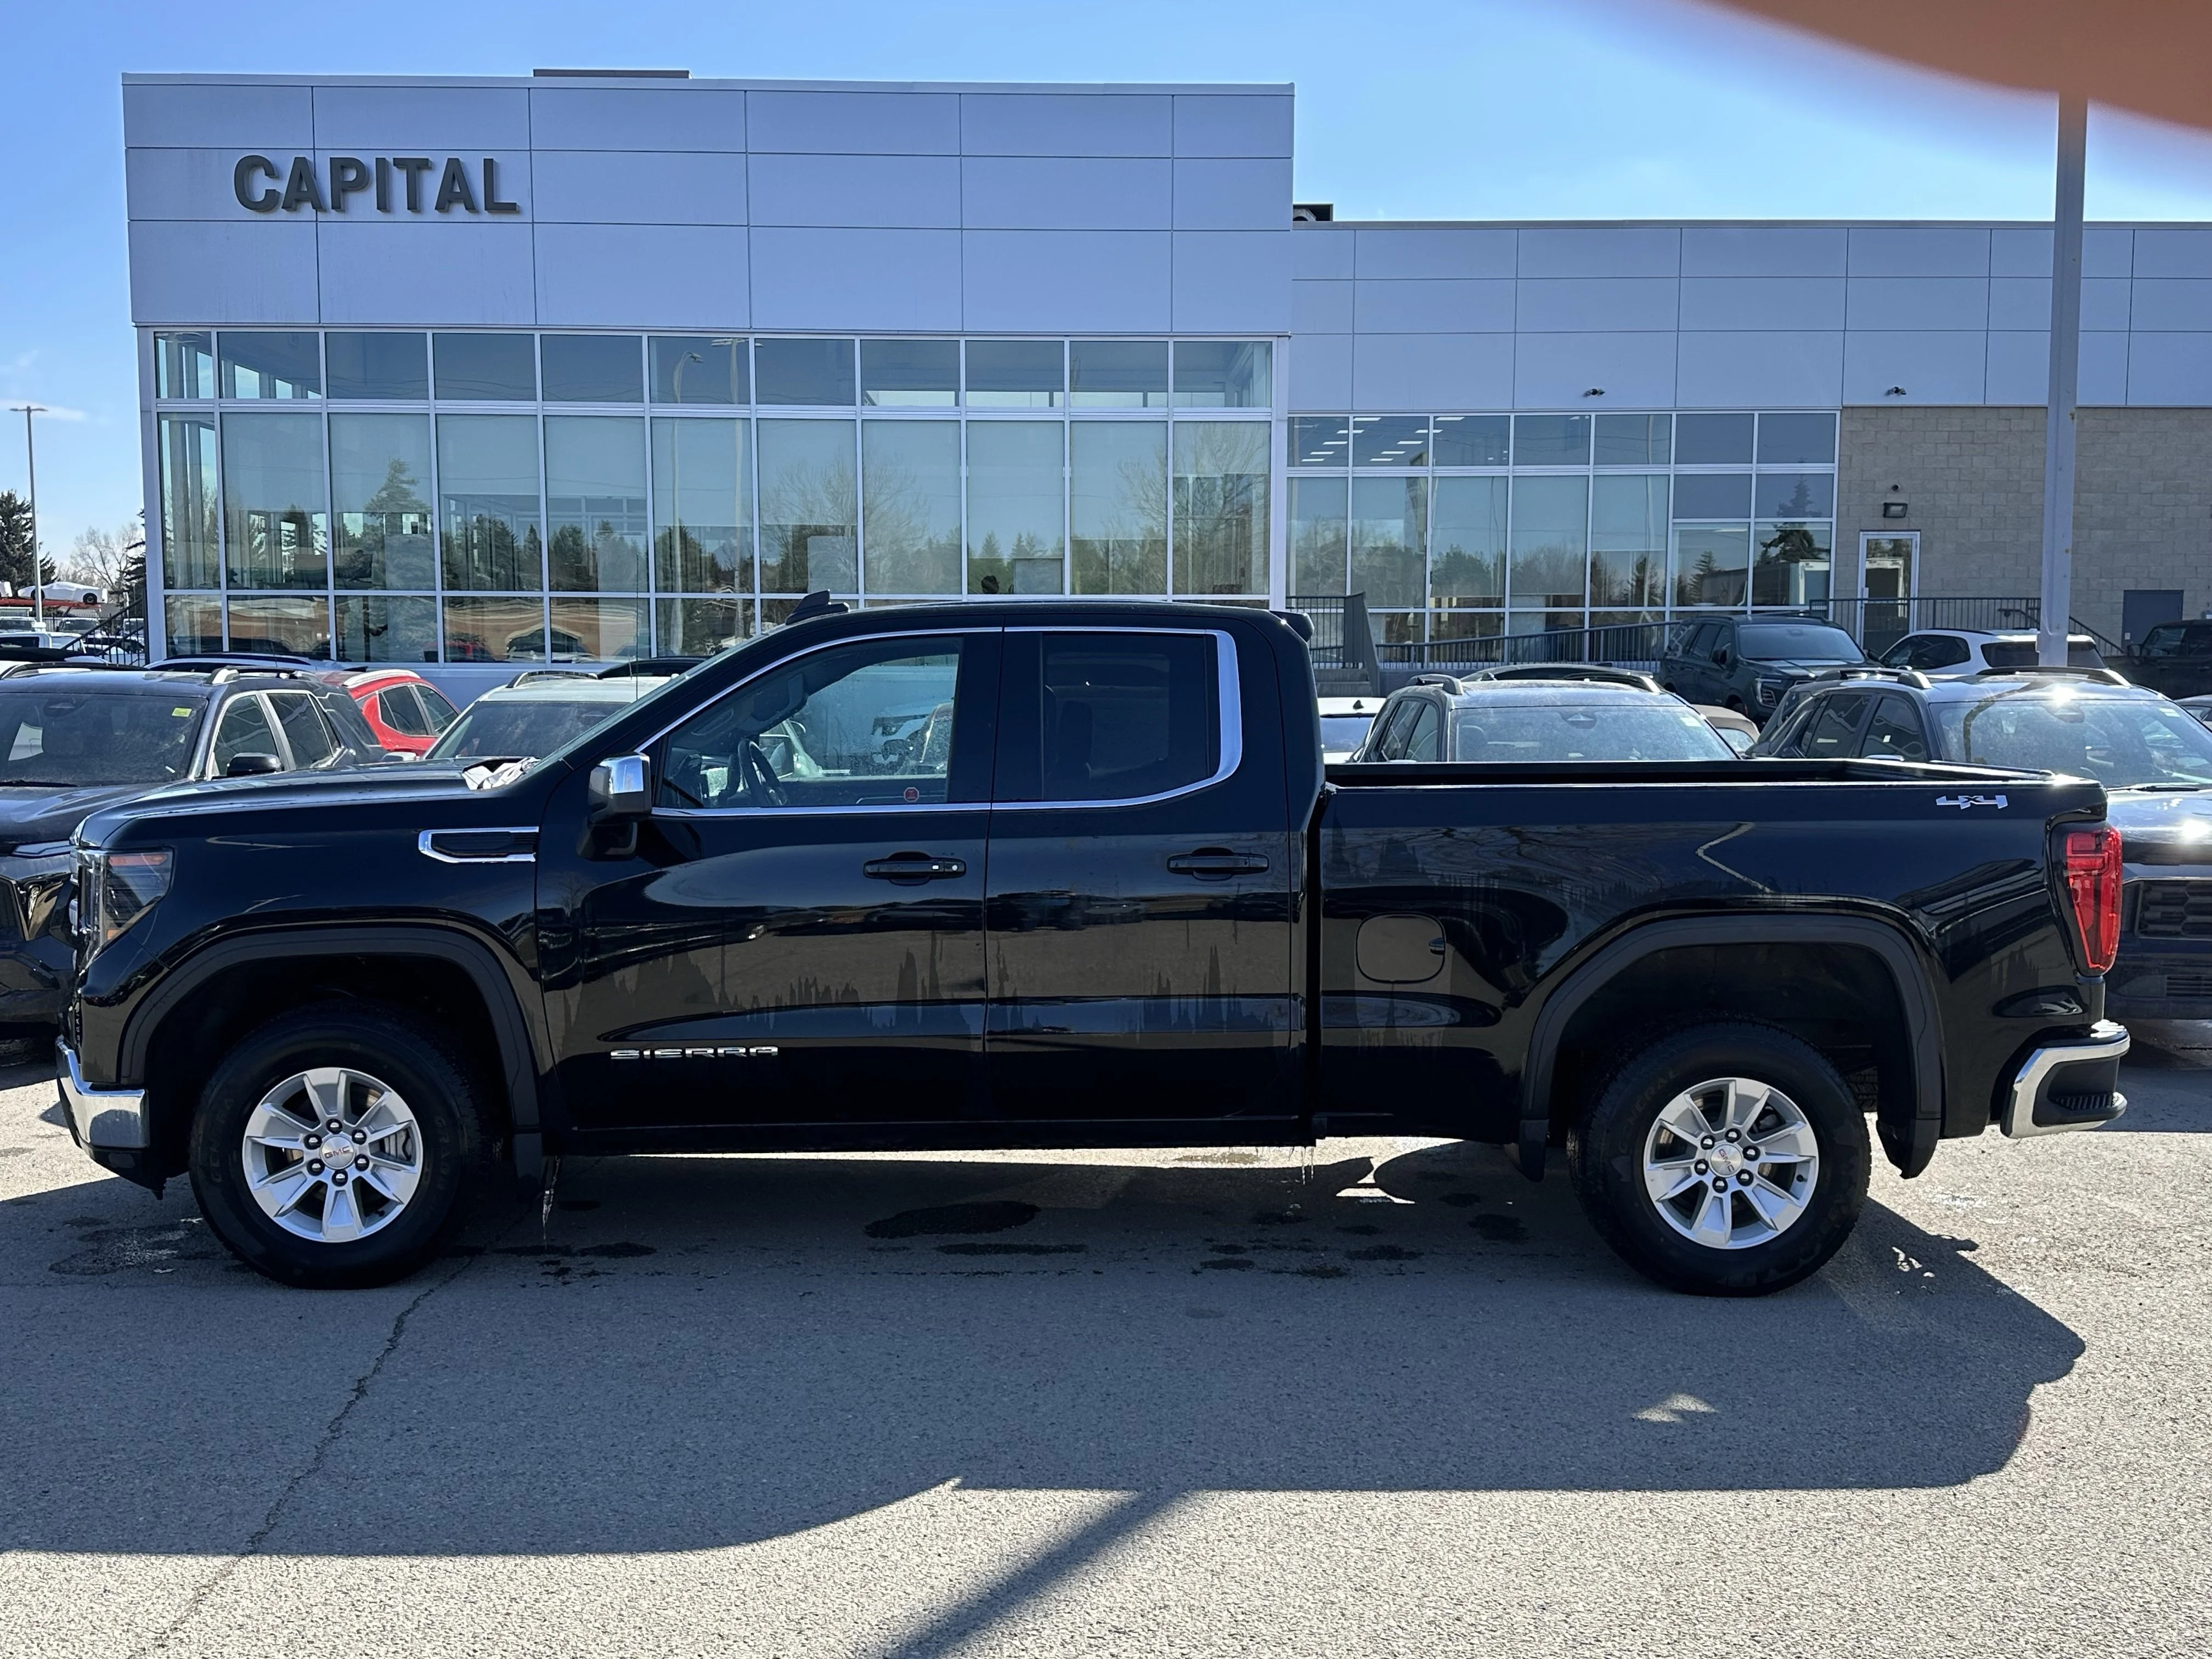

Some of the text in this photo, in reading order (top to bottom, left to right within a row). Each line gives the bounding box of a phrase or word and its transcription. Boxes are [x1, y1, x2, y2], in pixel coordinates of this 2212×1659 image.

[234, 155, 520, 212] CAPITAL
[611, 1046, 778, 1060] SIERRA
[324, 1146, 351, 1159] GMC
[1718, 1148, 1735, 1172] GMC
